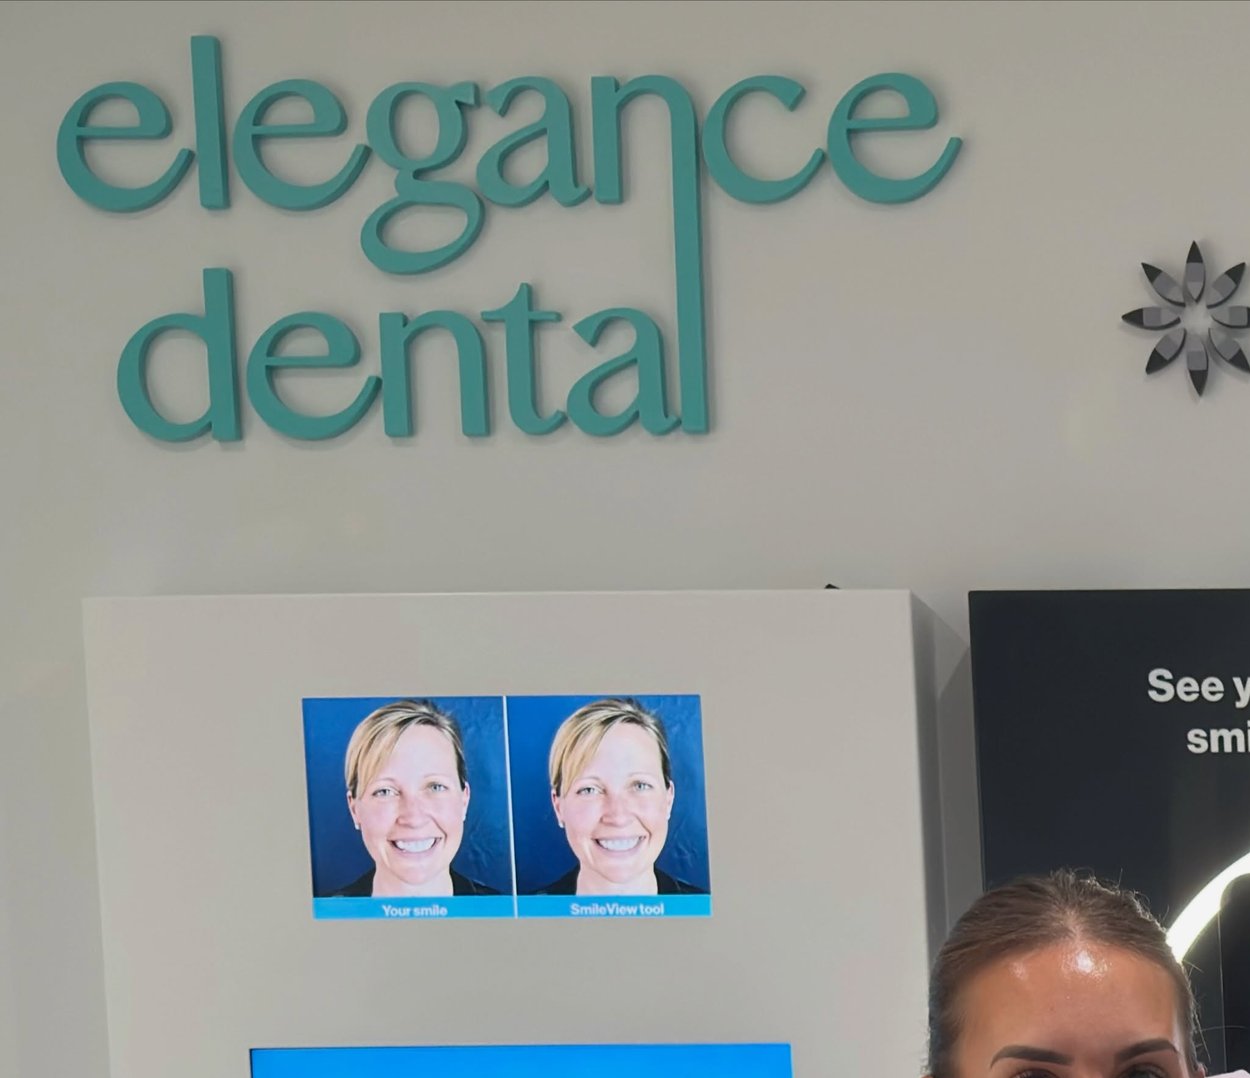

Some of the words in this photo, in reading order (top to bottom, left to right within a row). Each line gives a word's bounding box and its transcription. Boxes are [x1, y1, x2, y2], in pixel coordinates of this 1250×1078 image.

[56, 35, 962, 275] elegance
[116, 267, 712, 443] dental
[1147, 668, 1225, 703] See
[382, 904, 411, 917] Your
[413, 904, 448, 916] smile
[570, 902, 638, 916] SmileView
[640, 902, 664, 915] tool
